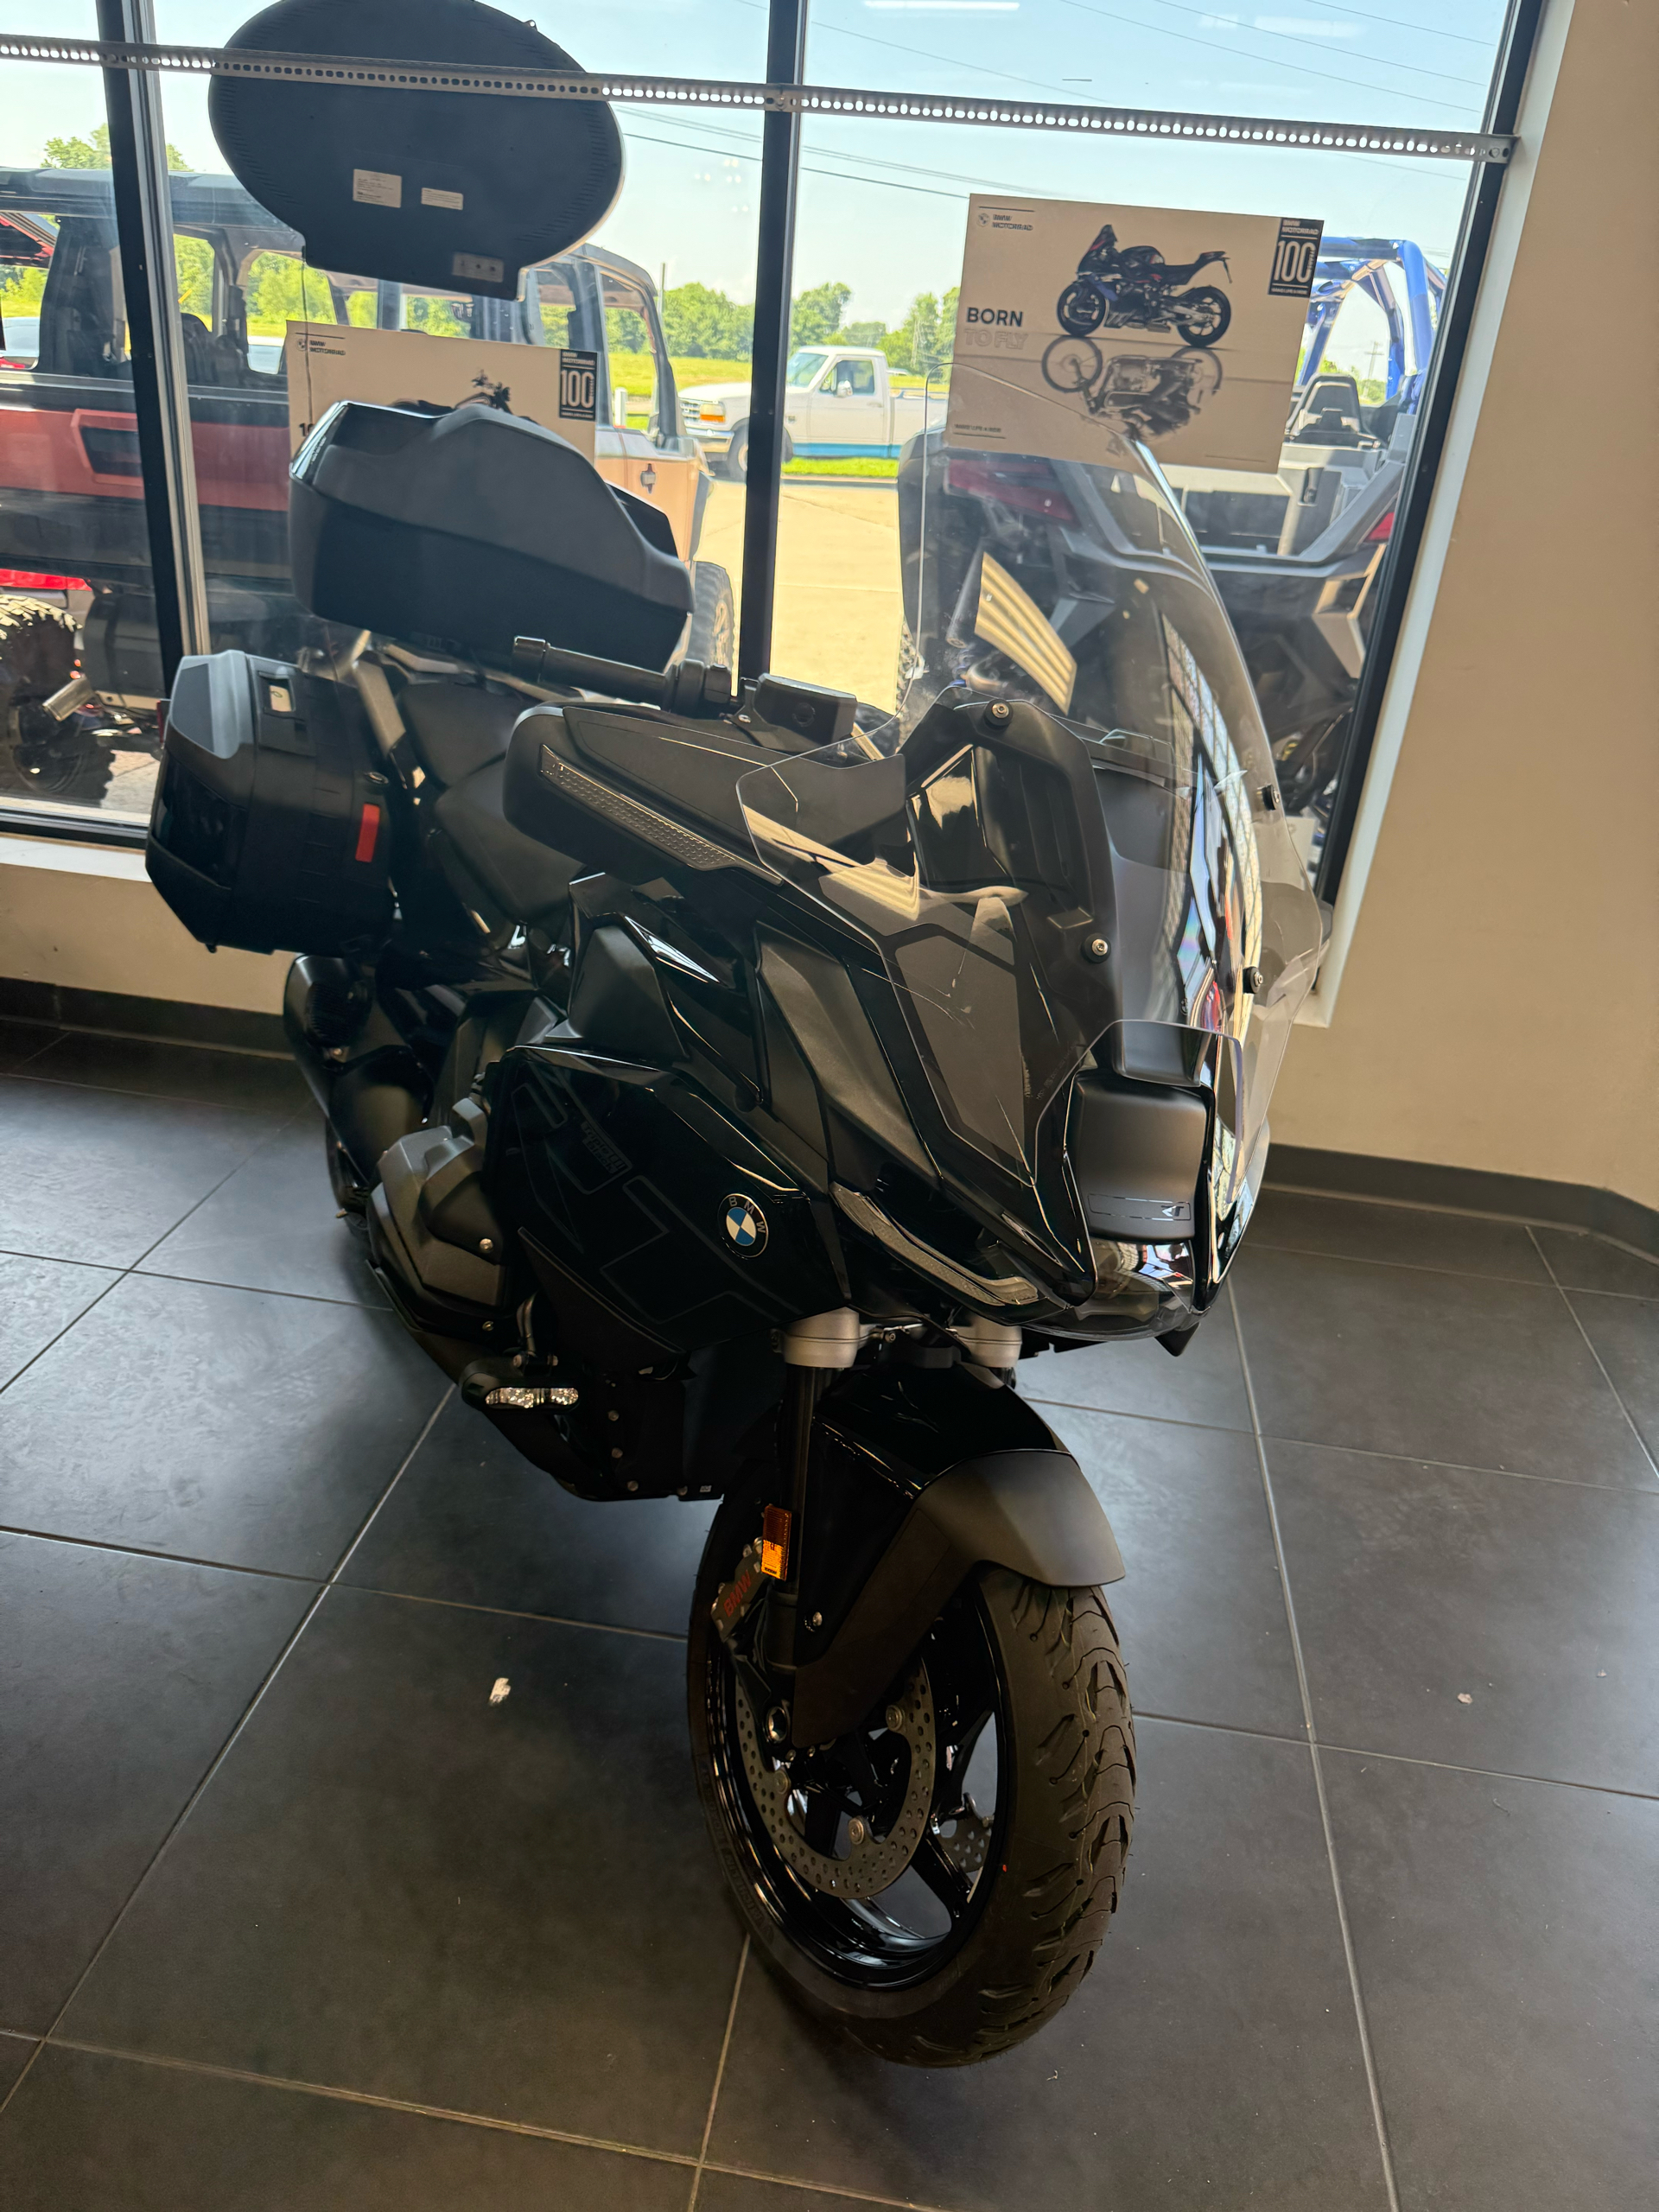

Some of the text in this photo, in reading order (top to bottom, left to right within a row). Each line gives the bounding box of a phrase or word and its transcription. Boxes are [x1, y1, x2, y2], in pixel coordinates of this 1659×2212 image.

[1274, 240, 1316, 283] 100
[966, 307, 1023, 327] BORN
[963, 328, 1029, 350] TO FLY
[561, 370, 594, 409] 100
[728, 1195, 766, 1234] BMW
[723, 1568, 752, 1618] BMW
